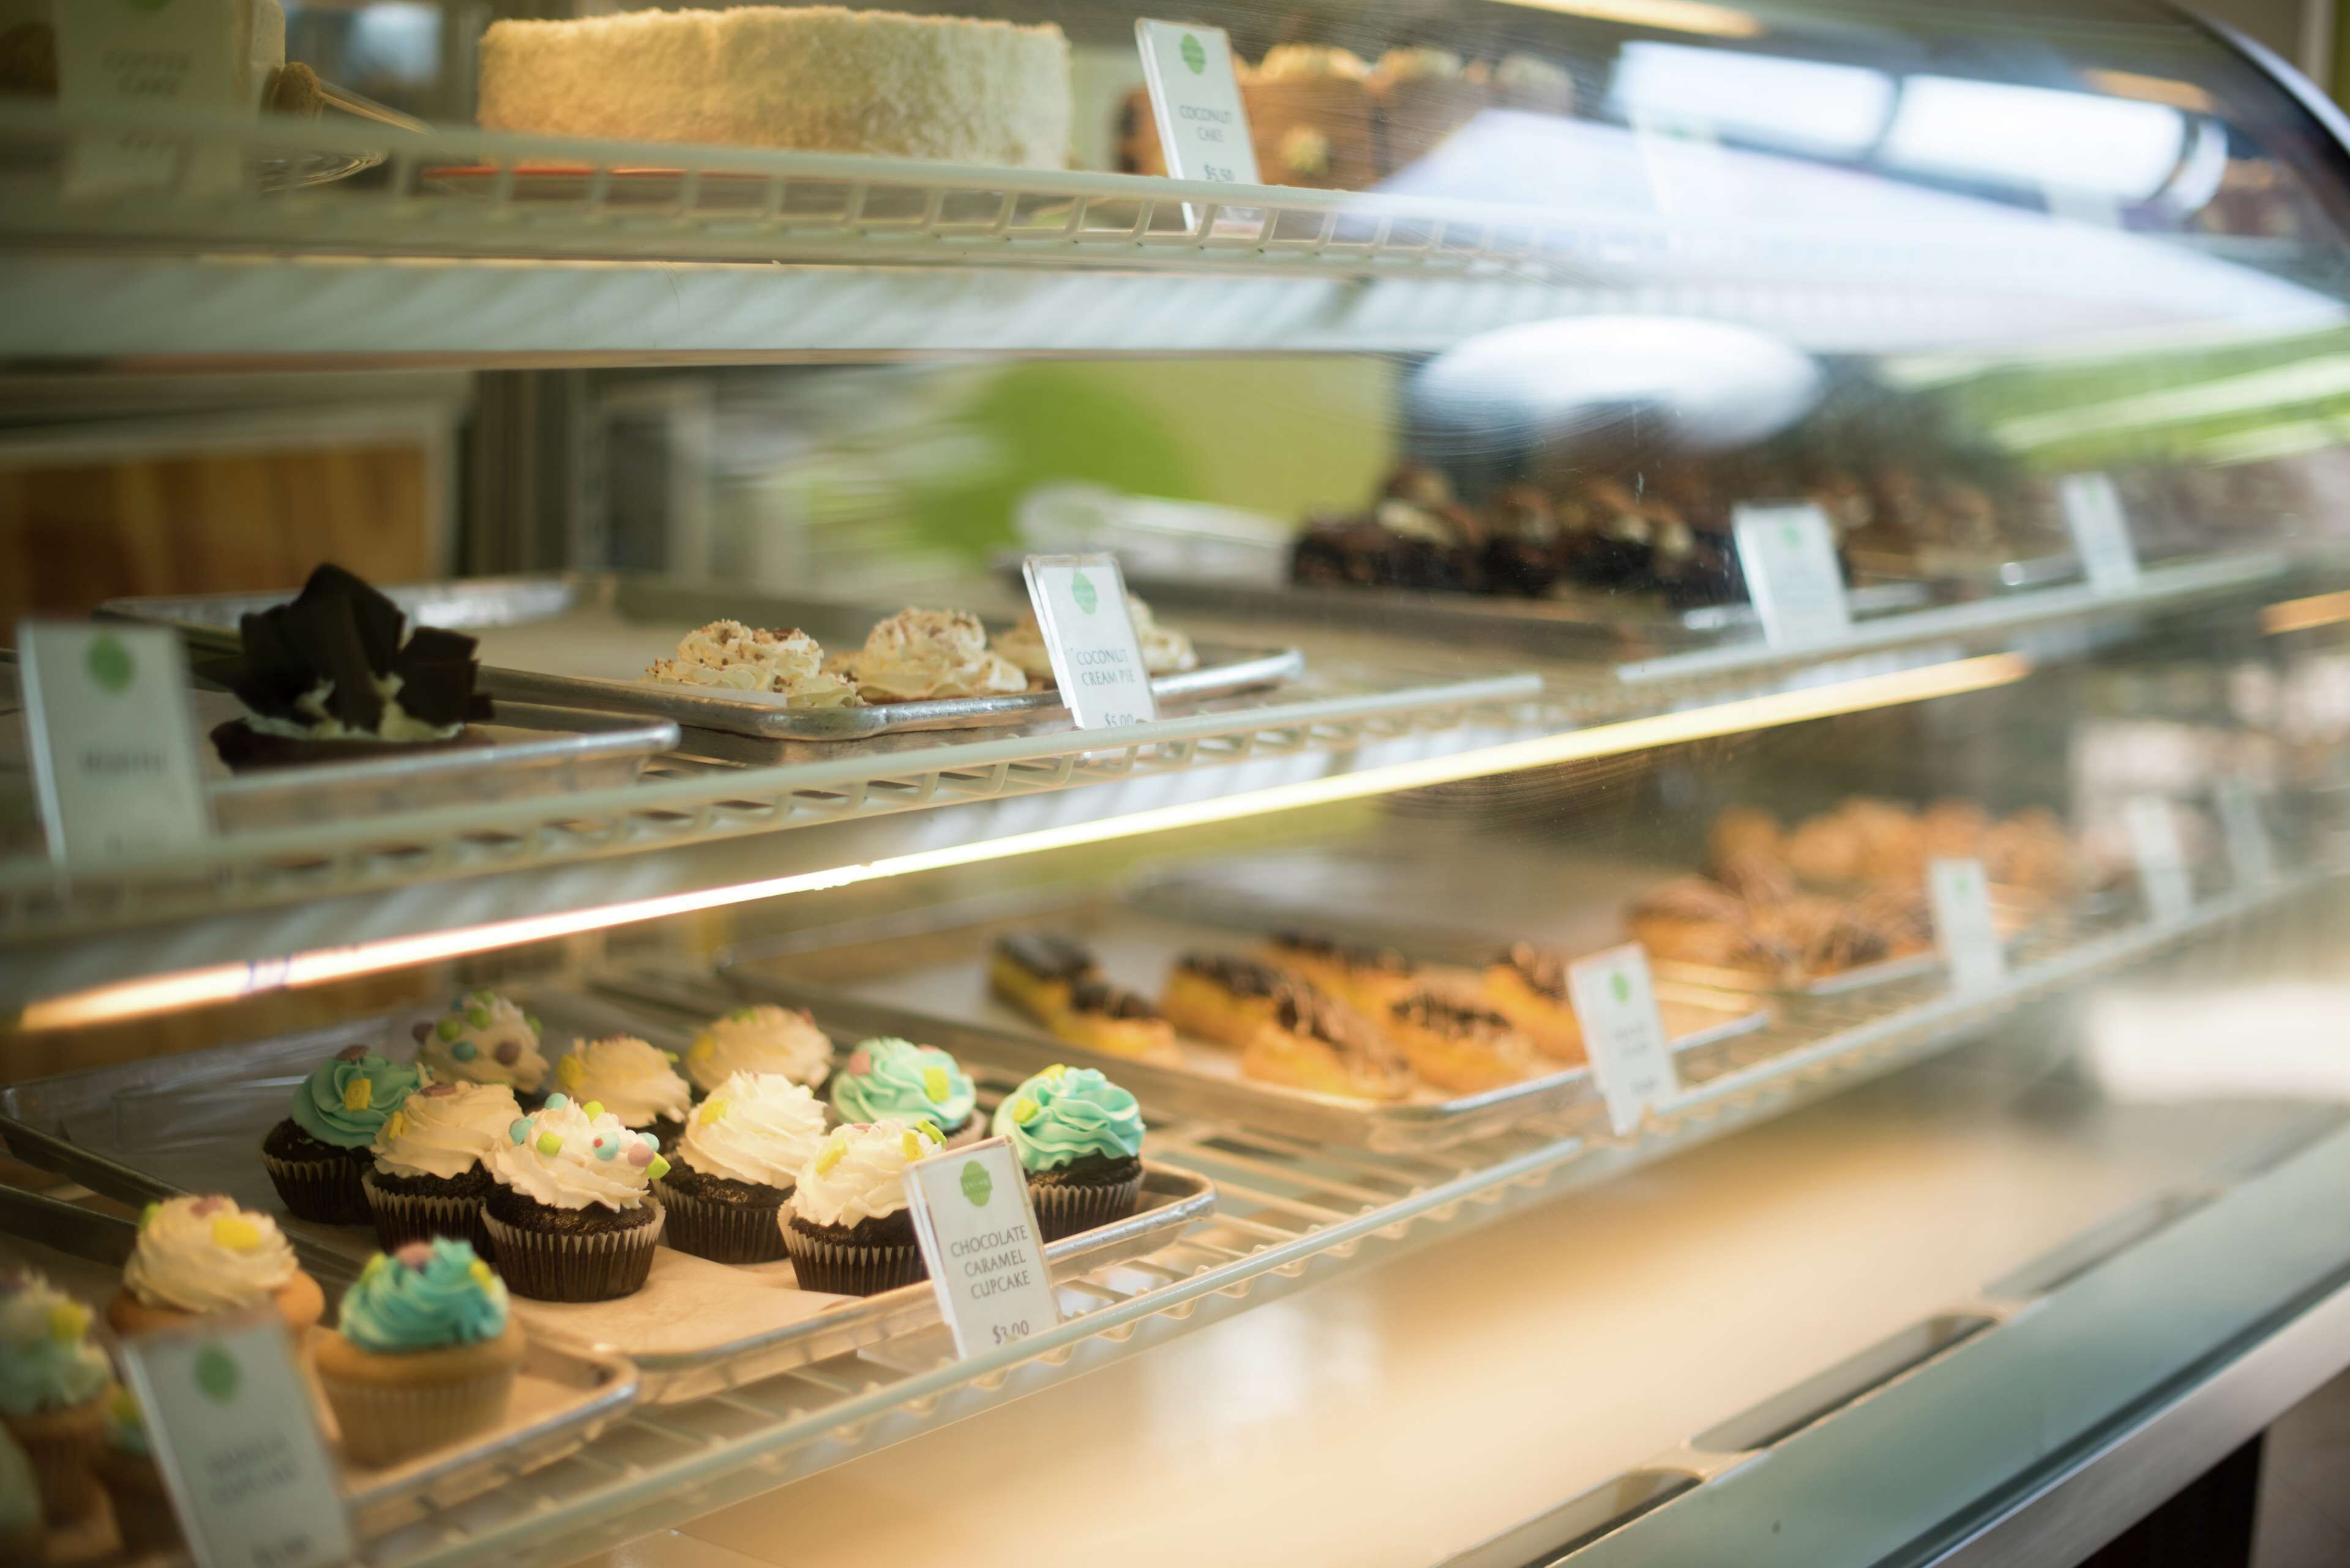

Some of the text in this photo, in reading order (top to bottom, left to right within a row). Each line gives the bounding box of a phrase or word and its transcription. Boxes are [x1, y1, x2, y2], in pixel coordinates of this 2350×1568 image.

[1179, 105, 1232, 124] COCONUT
[1077, 649, 1129, 665] COCONUT
[1082, 668, 1136, 686] CREAM PIE
[1104, 711, 1134, 728] $500
[951, 1225, 1028, 1258] CHOCOLATE
[964, 1249, 1027, 1278] CARAMEL
[971, 1270, 1031, 1300] CUPCAKE
[992, 1320, 1030, 1346] $300
